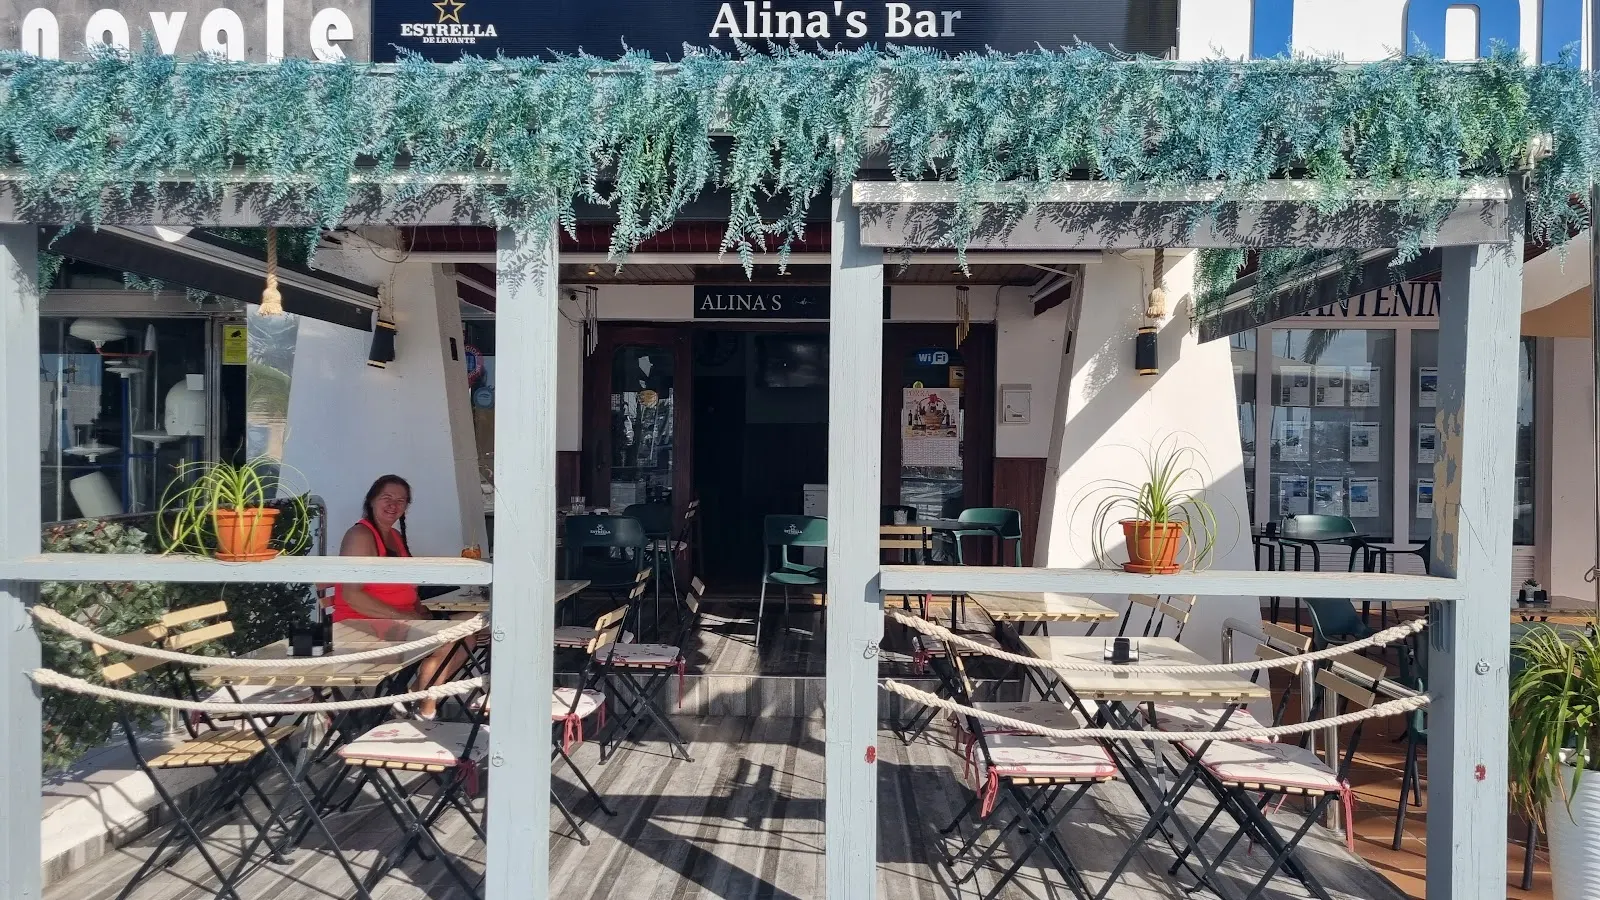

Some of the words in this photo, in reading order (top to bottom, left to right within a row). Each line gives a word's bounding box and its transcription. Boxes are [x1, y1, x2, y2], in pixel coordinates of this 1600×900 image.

[709, 1, 868, 38] Alina's
[884, 2, 962, 37] Bar
[22, 0, 354, 63] navale
[400, 23, 498, 37] ESTRELLA
[422, 36, 436, 44] DE
[700, 294, 782, 311] ALINA'S
